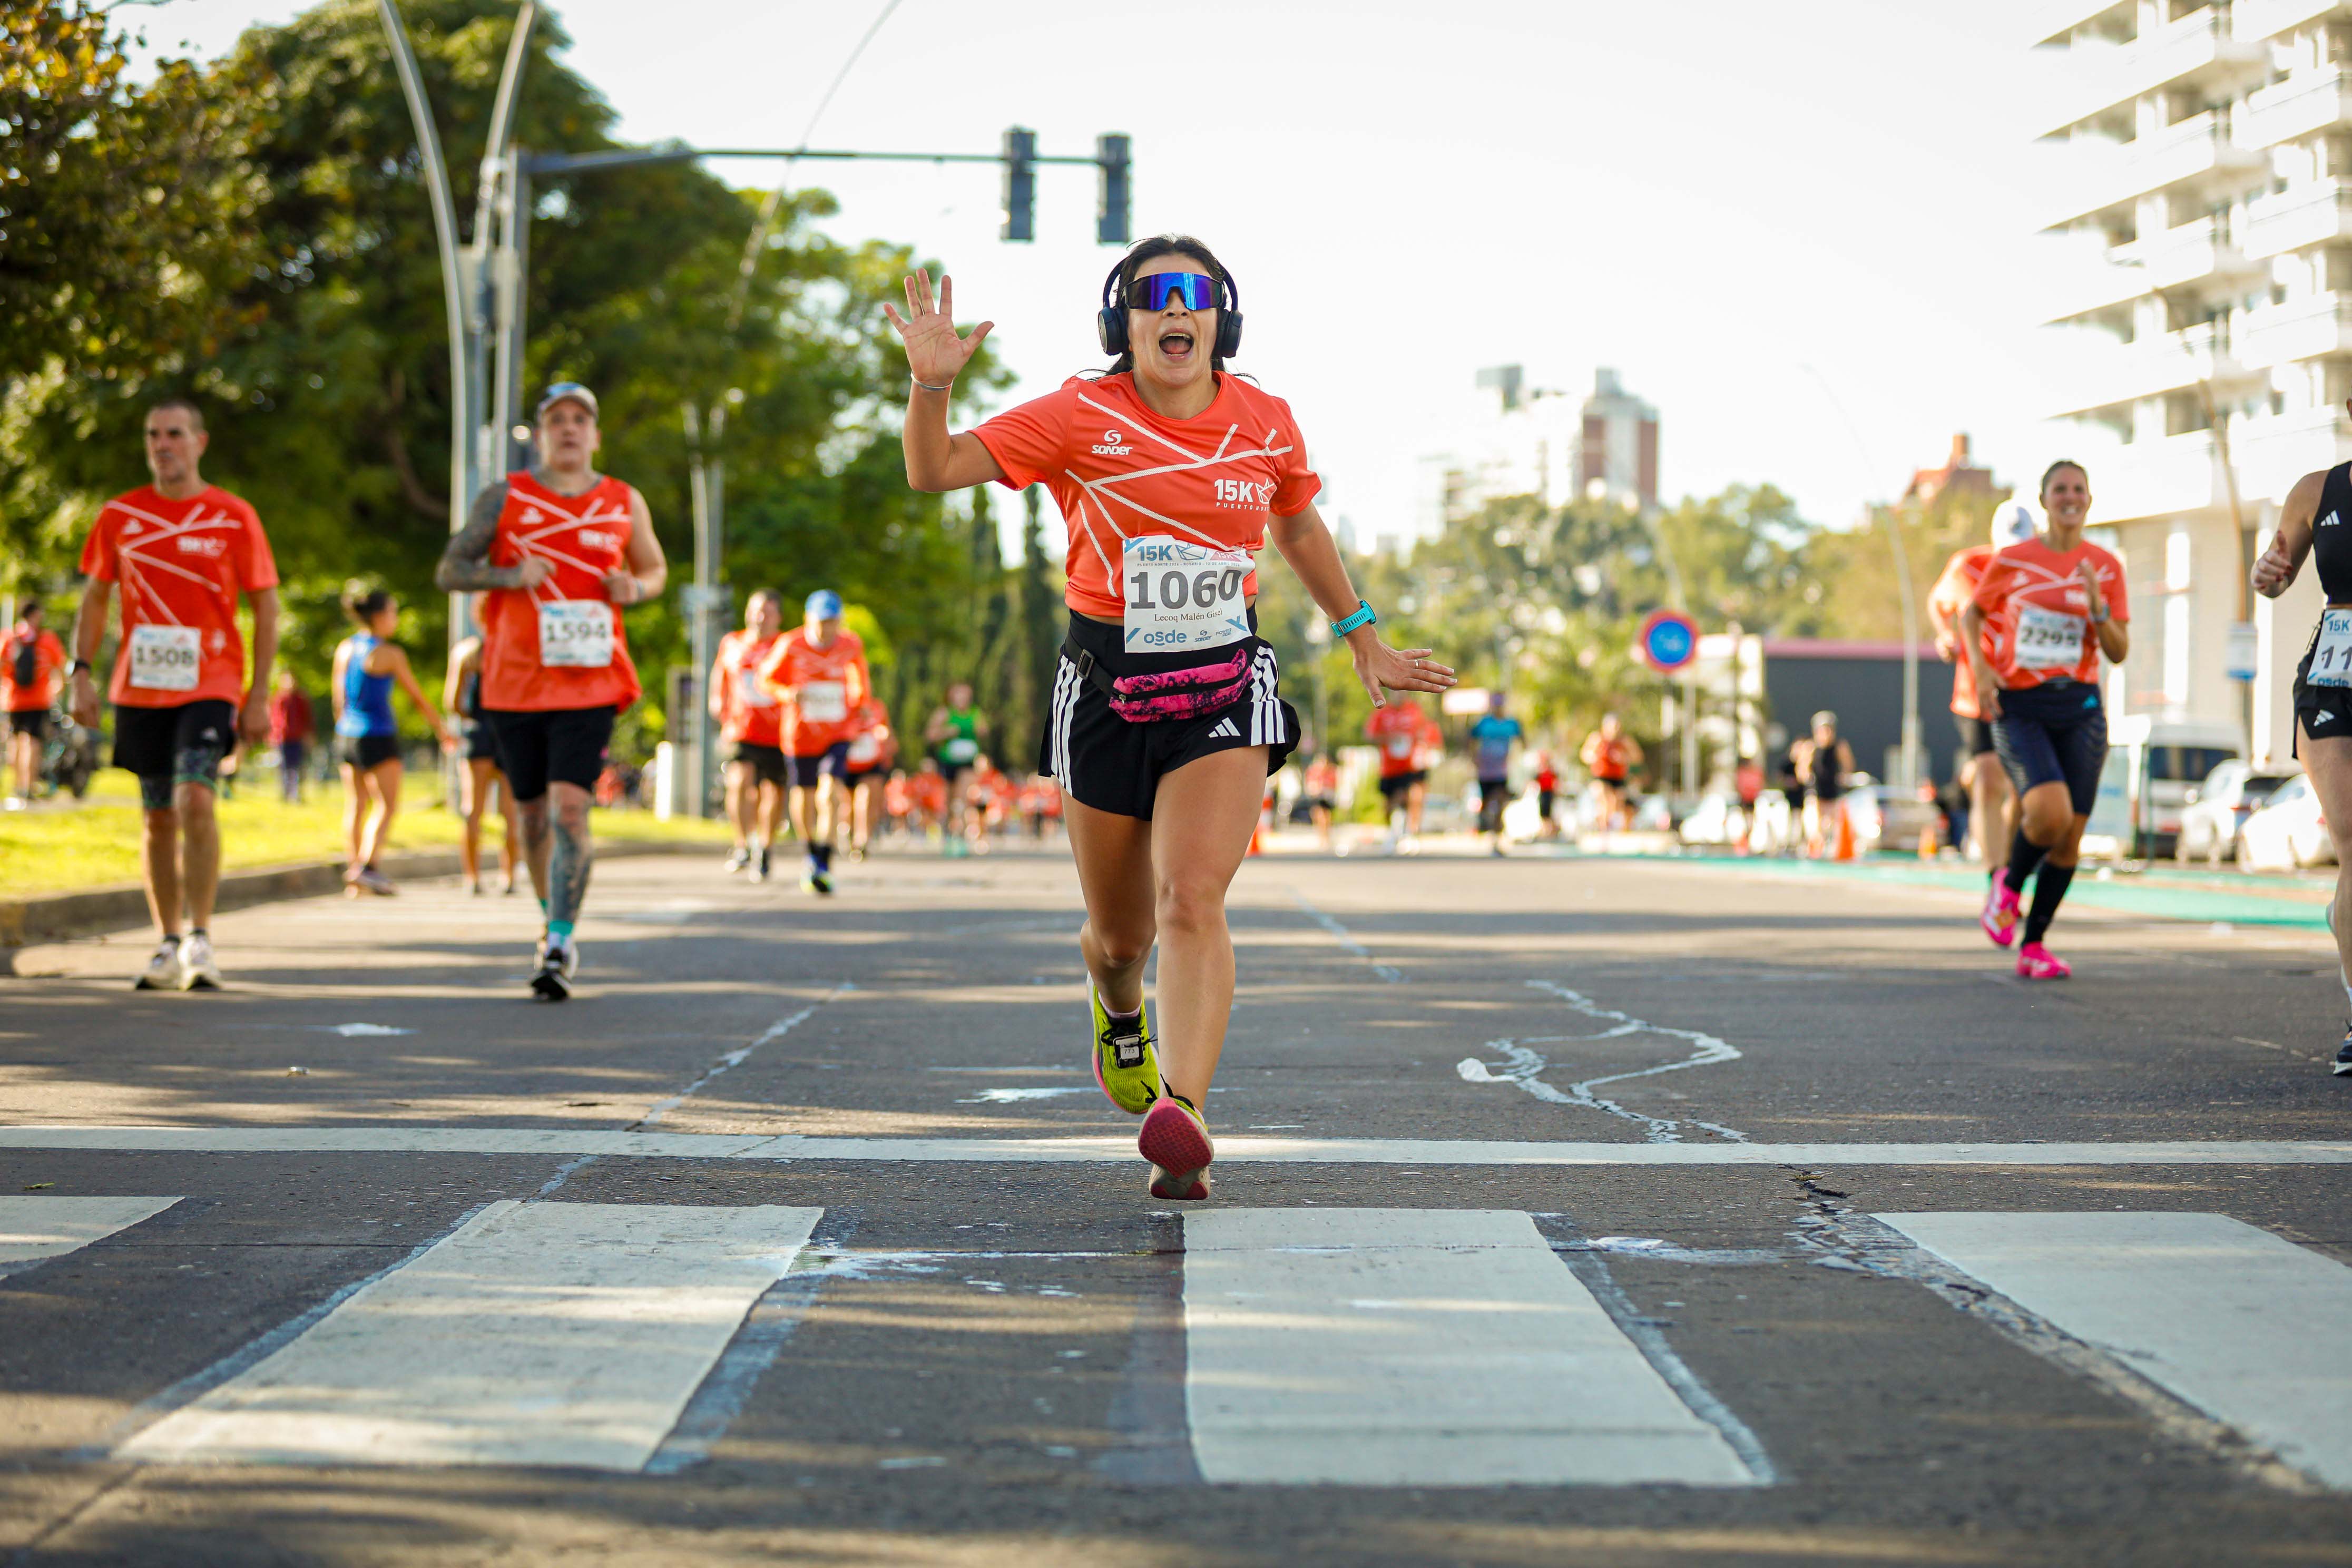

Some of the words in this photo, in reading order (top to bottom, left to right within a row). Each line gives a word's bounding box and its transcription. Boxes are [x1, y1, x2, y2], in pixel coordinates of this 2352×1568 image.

[1214, 479, 1254, 503] 15K
[1216, 502, 1253, 511] PUERTO
[1137, 545, 1173, 561] 15K
[1217, 551, 1234, 560] 15K
[1131, 569, 1242, 609] 1060
[1154, 614, 1178, 622] Lecoq
[1207, 607, 1223, 619] Gisel
[546, 622, 606, 642] 1594
[2328, 619, 2350, 632] 15K
[1144, 629, 1187, 645] osde
[135, 646, 194, 666] 1508
